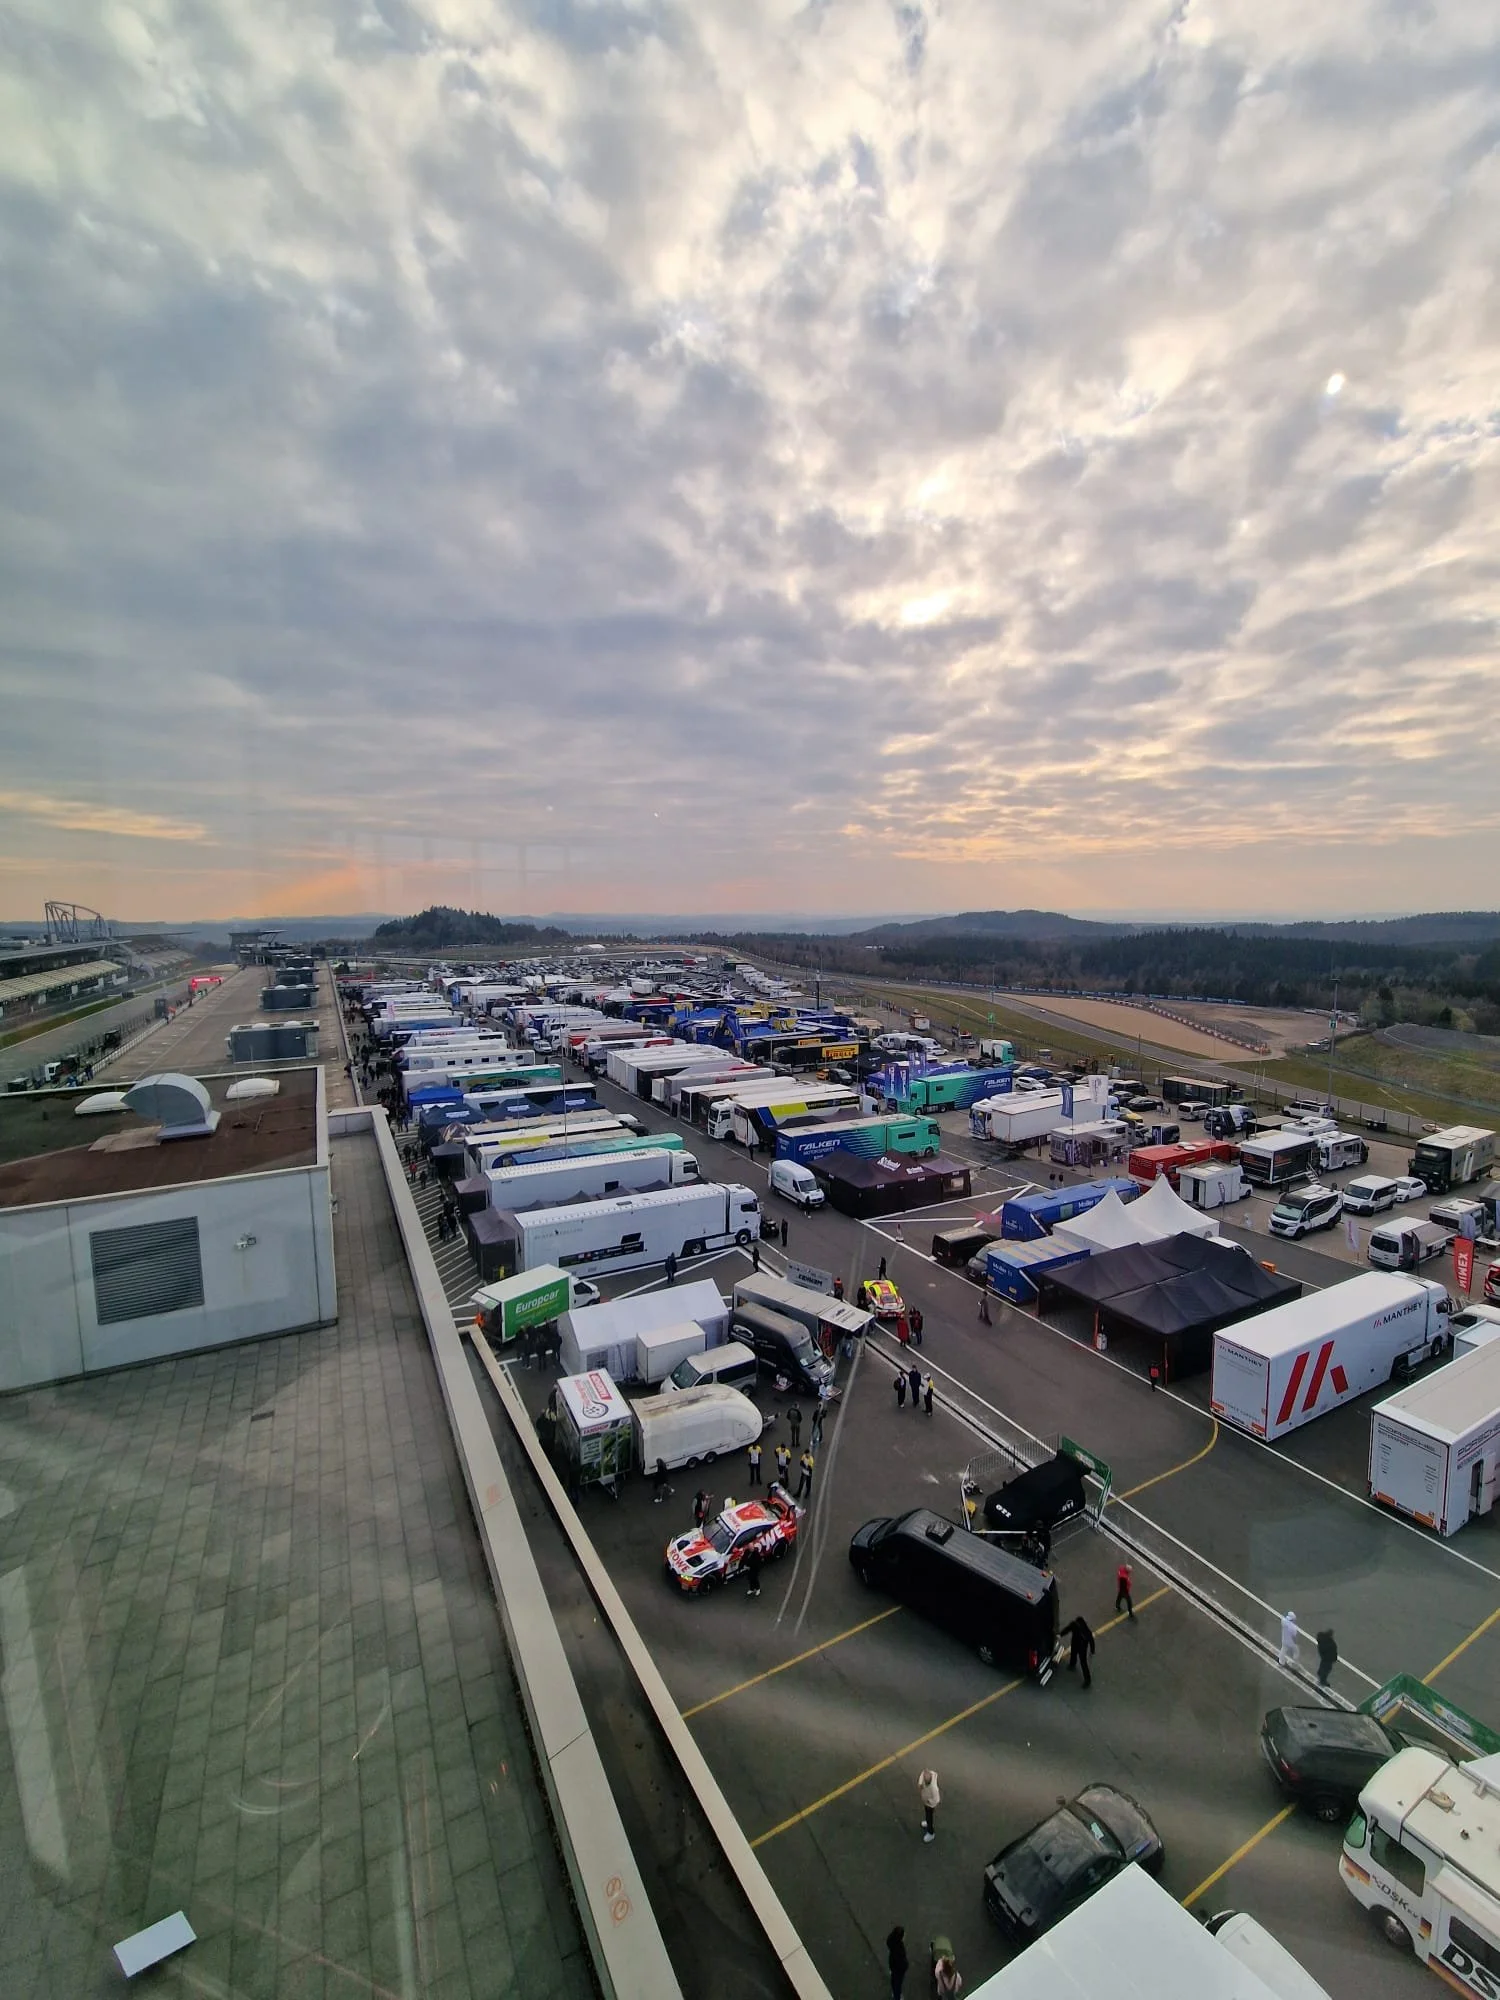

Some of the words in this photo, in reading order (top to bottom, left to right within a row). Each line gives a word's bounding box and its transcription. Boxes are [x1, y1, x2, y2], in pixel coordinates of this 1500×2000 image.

[799, 1139, 841, 1152] FALKEN
[515, 1289, 560, 1314] Europcar
[1383, 1301, 1423, 1325] MANTHEY
[1227, 1348, 1263, 1367] MANTHEY
[1378, 1422, 1437, 1453] PORSCHE
[670, 1548, 691, 1573] ROWE
